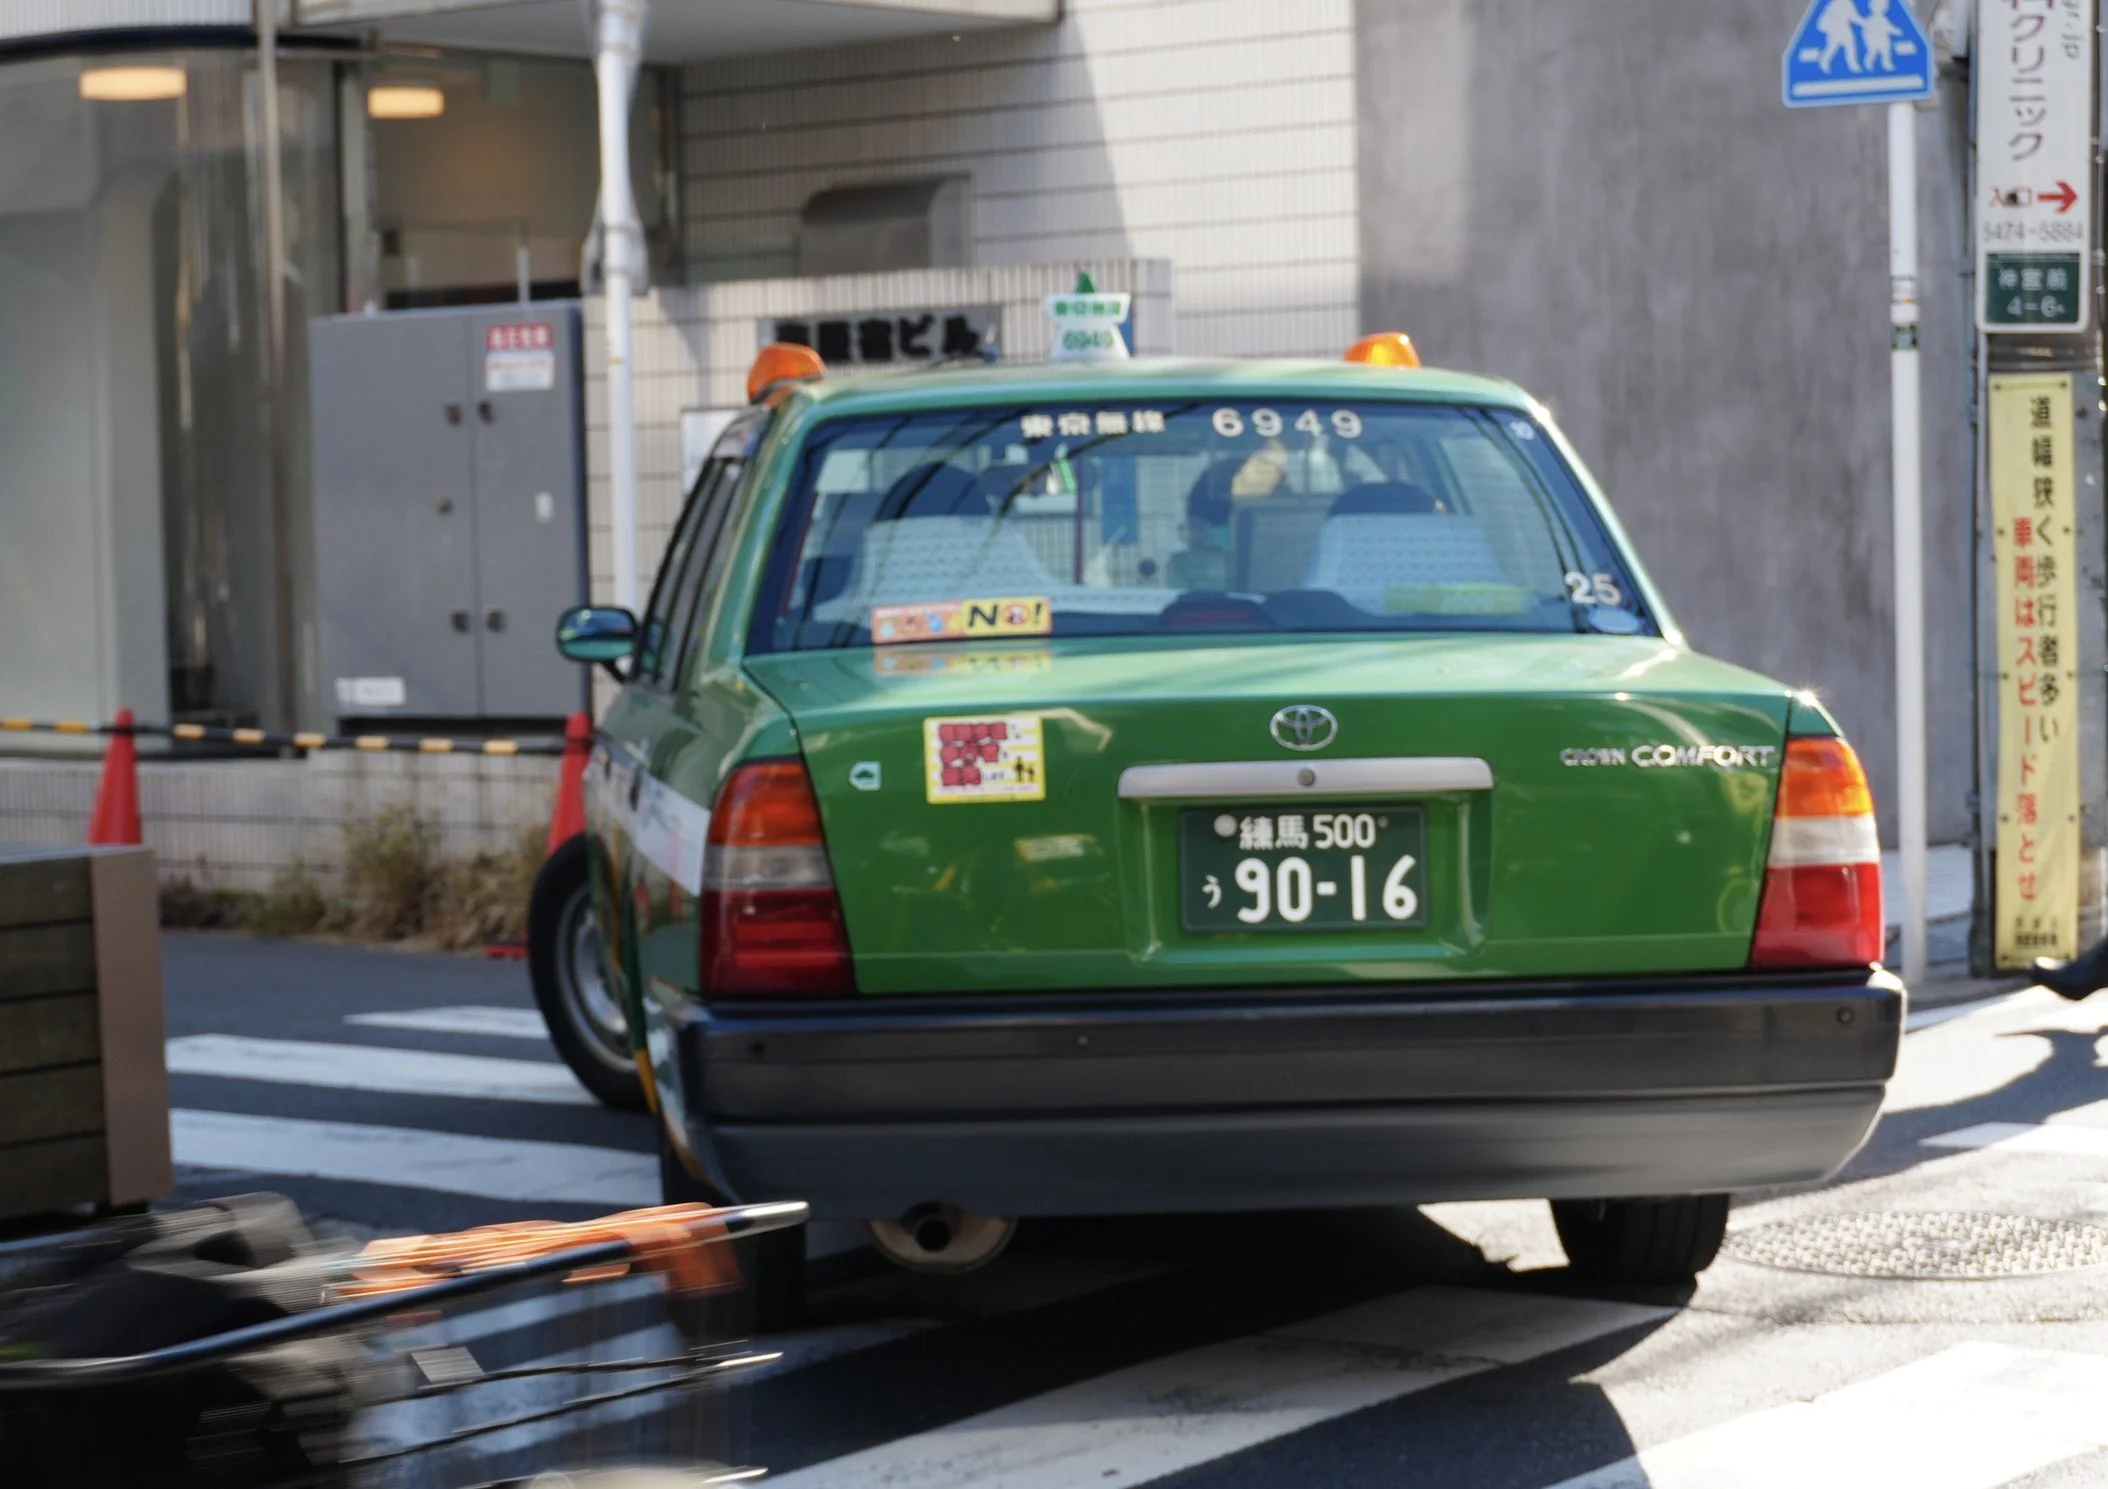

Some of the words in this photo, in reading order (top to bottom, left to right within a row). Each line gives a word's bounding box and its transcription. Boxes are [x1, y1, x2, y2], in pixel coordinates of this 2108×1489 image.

[1988, 183, 2034, 210] 入口
[1020, 411, 1165, 438] 東京無線
[1212, 407, 1363, 438] 6949
[1565, 571, 1621, 605] 25
[2013, 516, 2037, 902] 車両はスピード落とせ
[1631, 744, 1775, 767] COMFORT
[1202, 874, 1222, 909] う
[1234, 854, 1418, 924] 90-16
